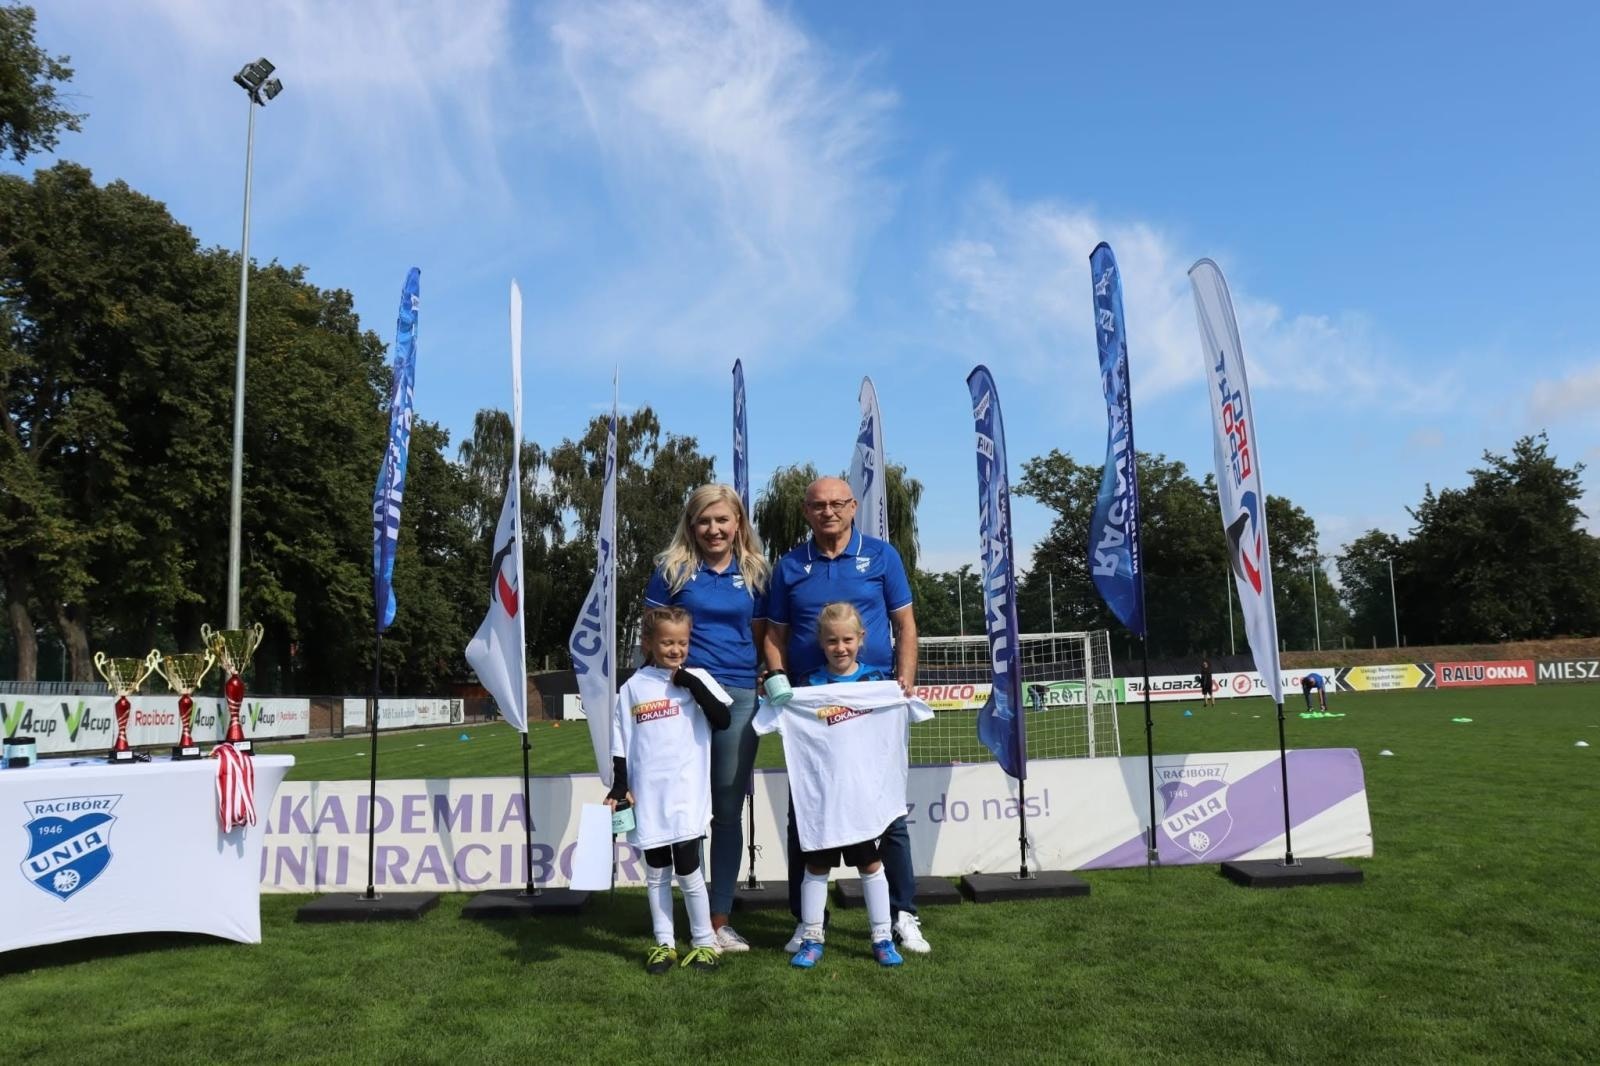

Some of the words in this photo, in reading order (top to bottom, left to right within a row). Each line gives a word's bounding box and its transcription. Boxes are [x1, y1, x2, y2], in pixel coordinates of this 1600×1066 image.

[1441, 666, 1485, 682] RALU
[1486, 666, 1528, 679] OKNA
[1538, 661, 1600, 680] MIESZ
[638, 707, 678, 721] LOKALNIE
[264, 794, 537, 835] KADEMIA
[928, 793, 970, 823] do
[982, 788, 1050, 820] nas!
[1168, 797, 1222, 832] UNIA
[38, 825, 63, 835] 1946
[30, 831, 102, 873] UNIA
[375, 842, 642, 885] RACIBR
